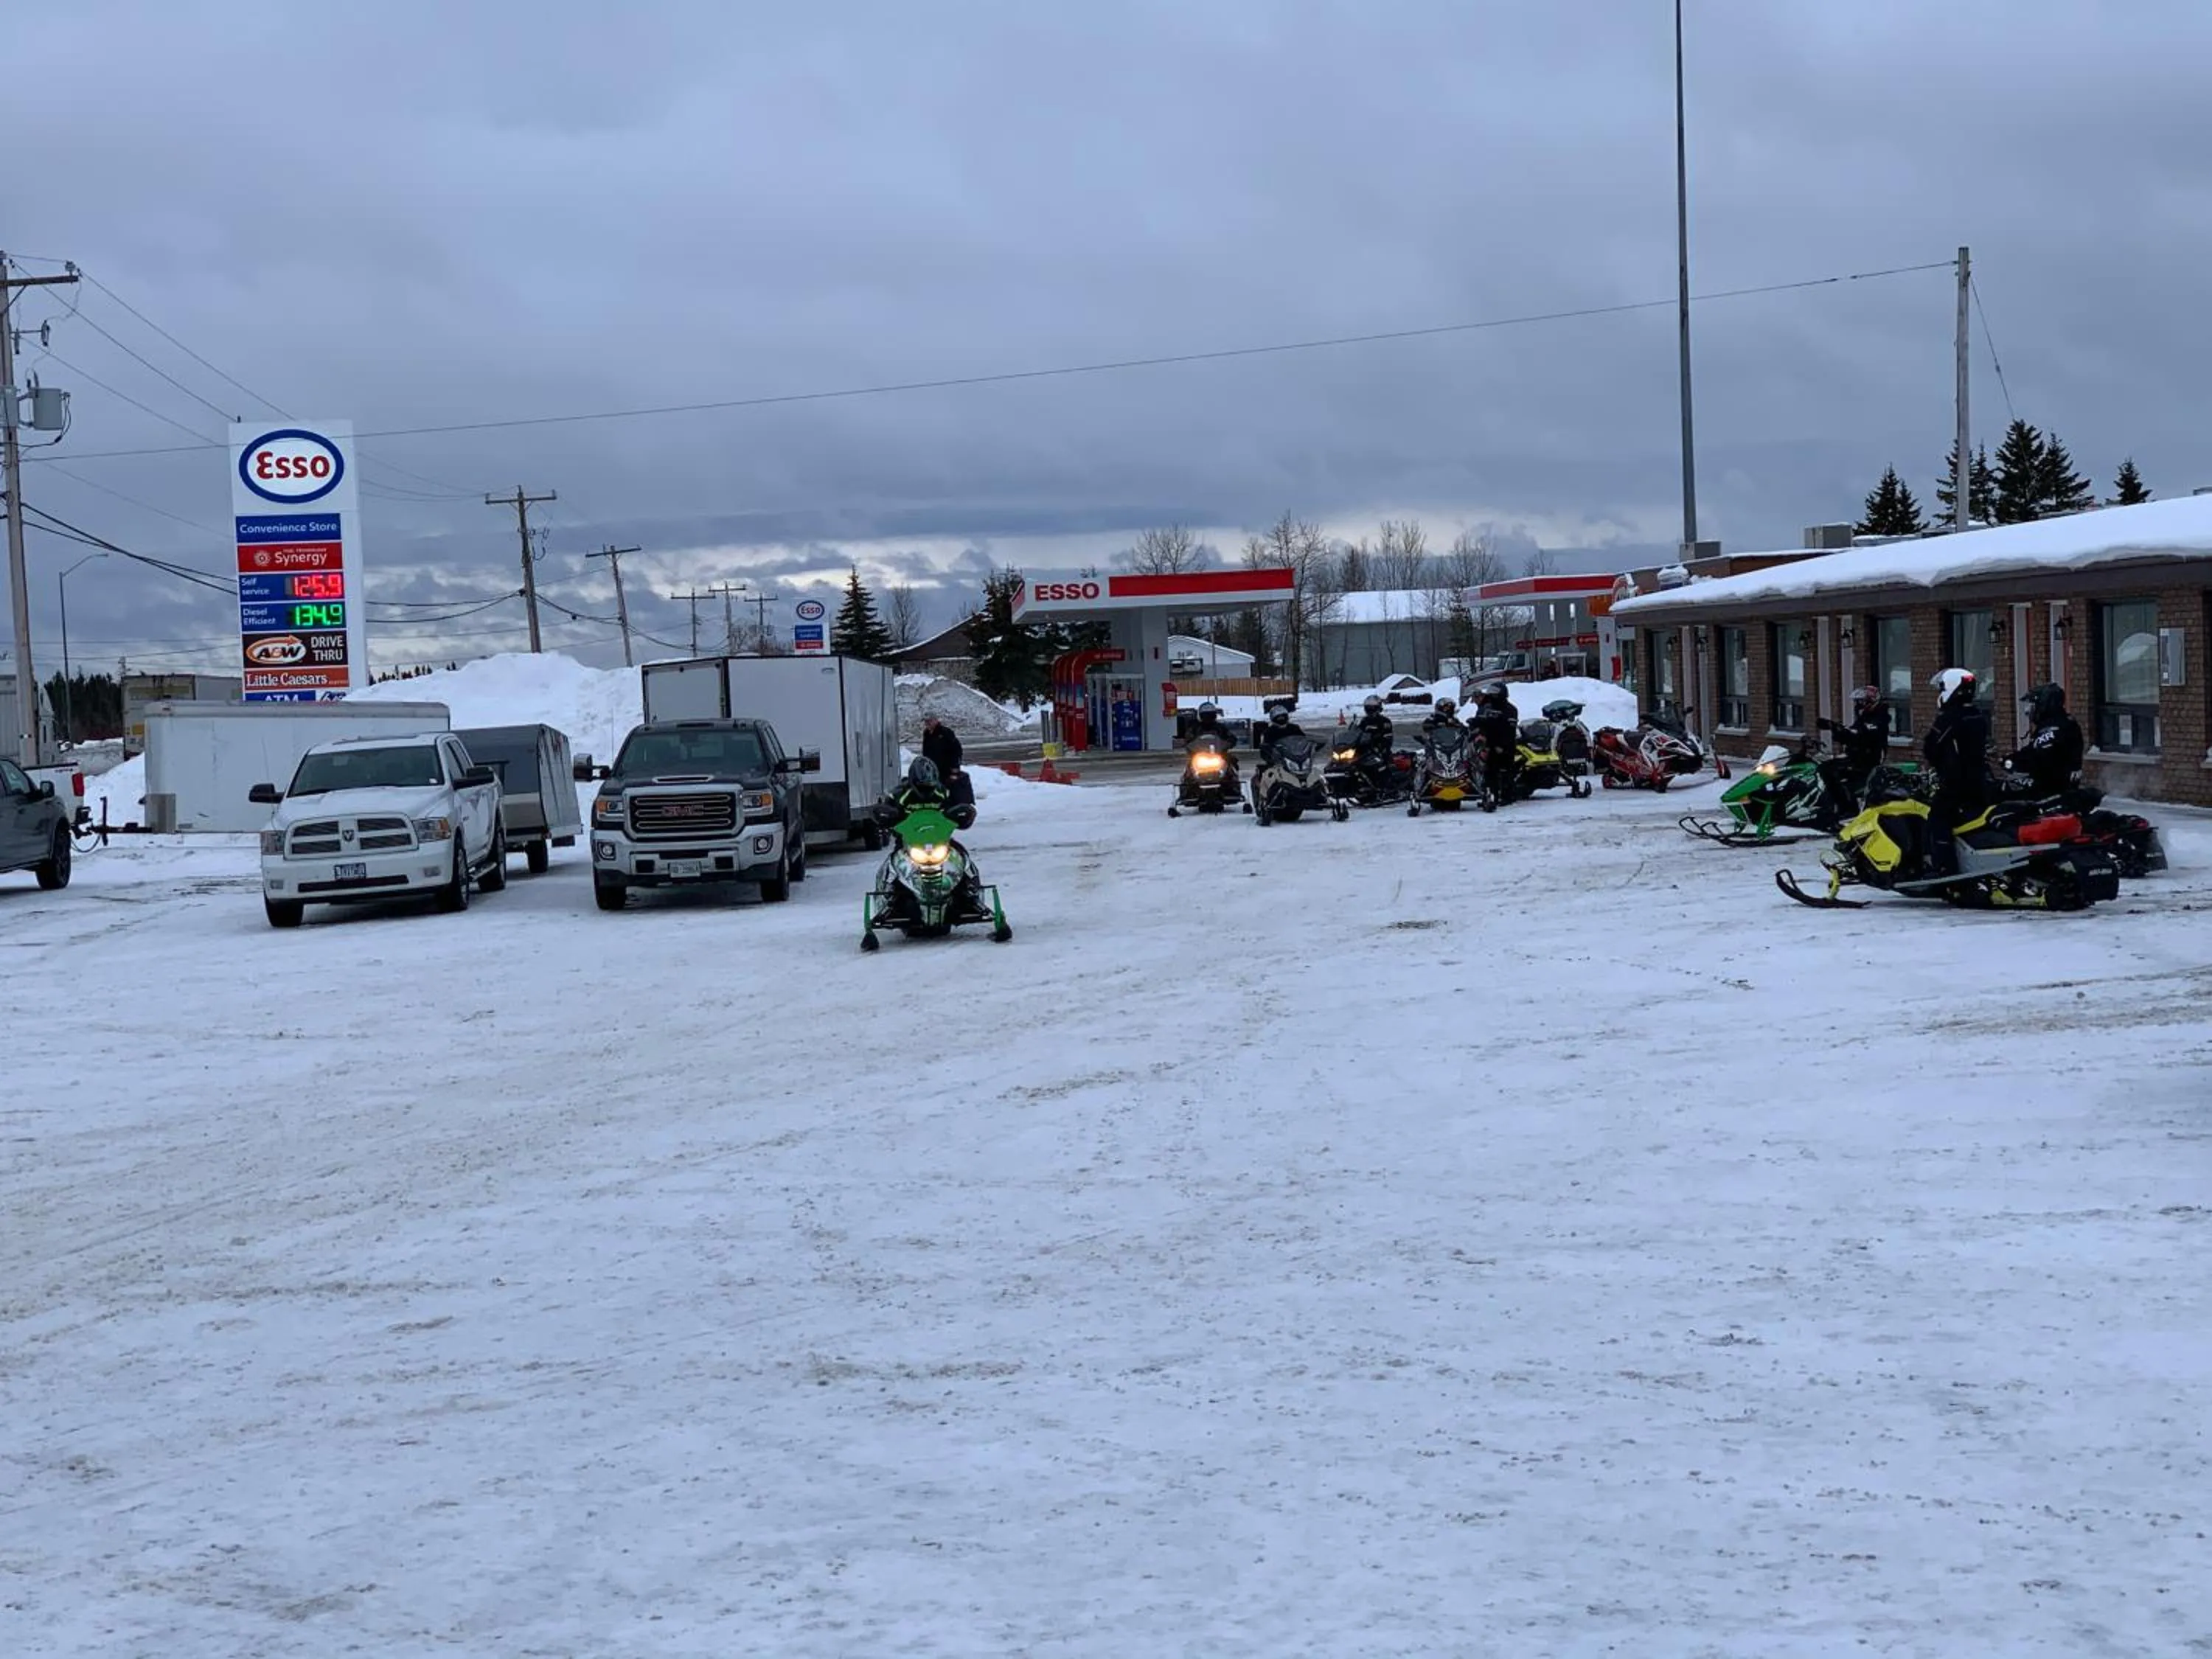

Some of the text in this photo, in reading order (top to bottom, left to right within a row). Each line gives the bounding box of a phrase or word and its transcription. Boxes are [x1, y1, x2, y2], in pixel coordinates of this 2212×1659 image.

[256, 451, 330, 479] Esso
[240, 522, 338, 534] Convenience Store
[274, 552, 327, 566] Synergy
[241, 577, 257, 586] Self
[294, 574, 342, 597] 125.9
[1034, 582, 1099, 601] ESSO
[243, 608, 267, 616] Diesel
[296, 604, 343, 626] 134.9
[243, 618, 276, 626] Efficient
[311, 635, 344, 648] DRIVE
[313, 649, 343, 661] THRU
[246, 672, 327, 686] Little Caesars
